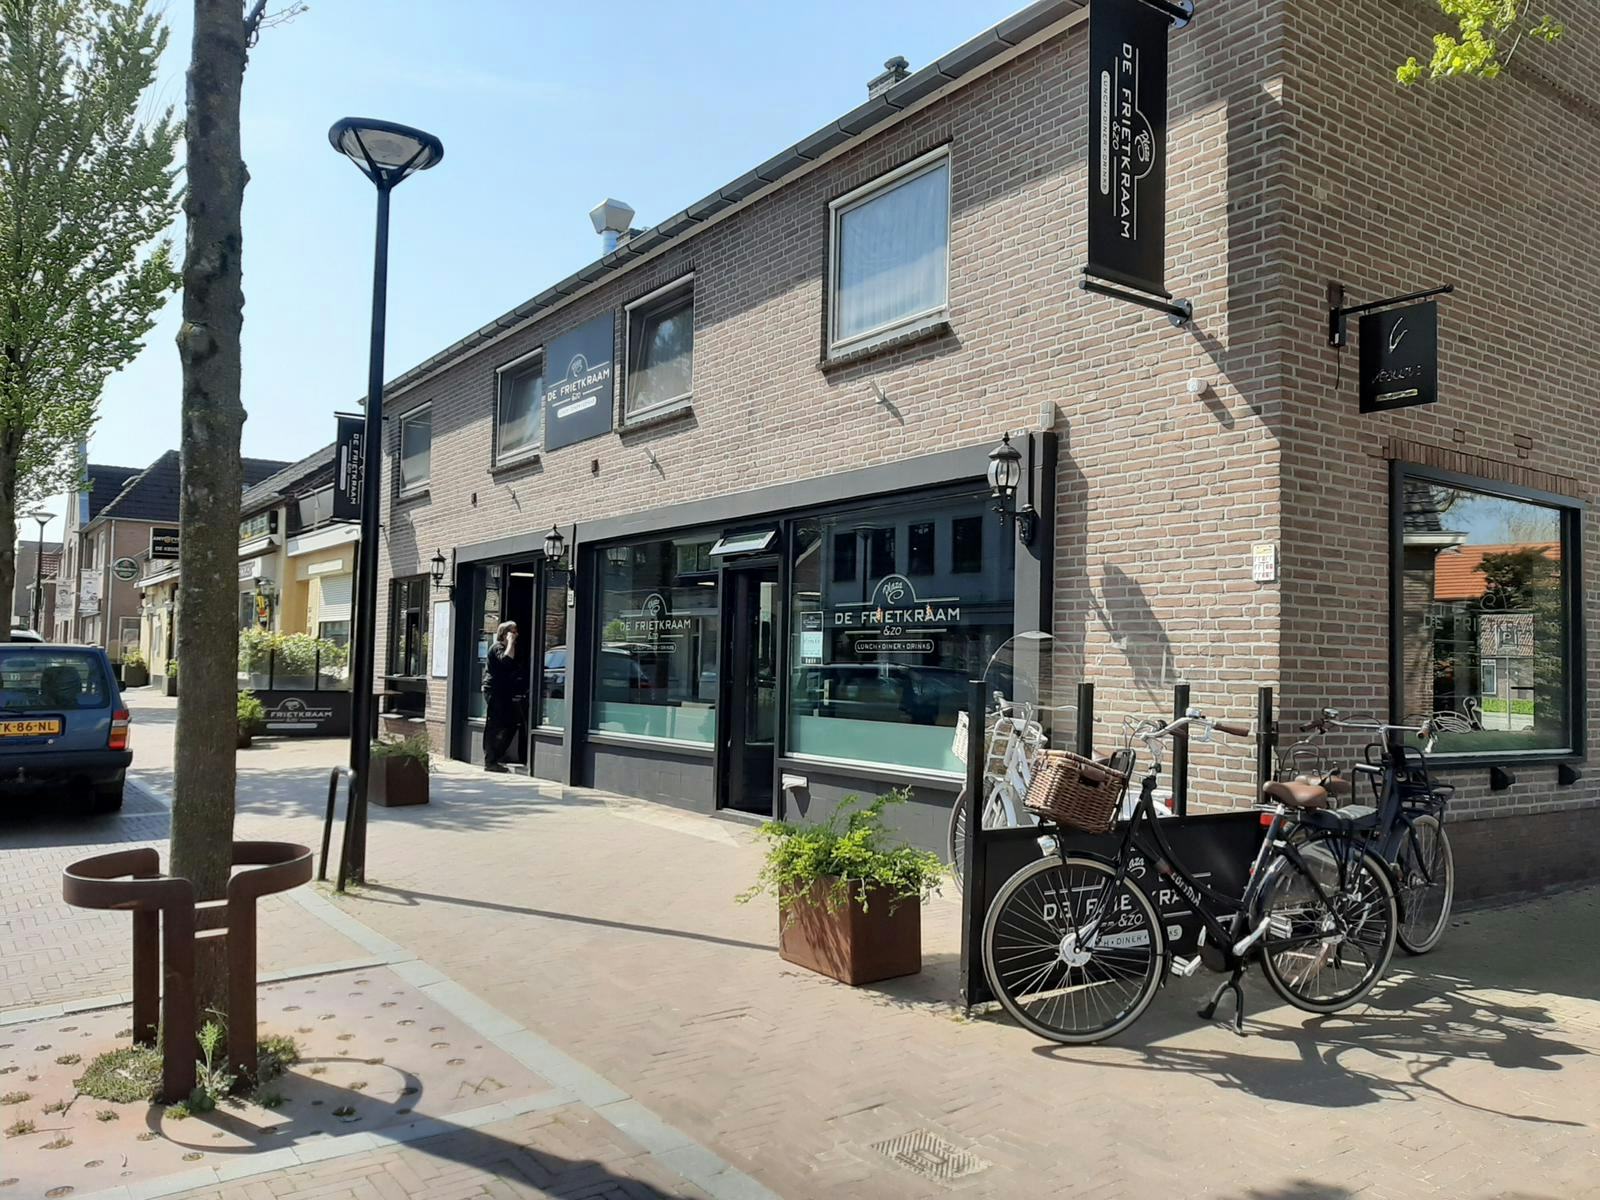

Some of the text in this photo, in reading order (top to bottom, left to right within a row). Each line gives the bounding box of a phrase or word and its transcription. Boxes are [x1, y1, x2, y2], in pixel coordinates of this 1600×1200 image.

[1120, 42, 1132, 239] DE FRIETKRAAM
[547, 390, 557, 401] DE
[560, 368, 610, 396] FRIETKRAAM
[350, 433, 360, 505] DE FRIETKRAAM
[834, 612, 853, 624] DE
[861, 607, 960, 623] FRIETKRAAM
[620, 619, 691, 631] DE FRIETKRAAM
[0, 722, 54, 733] K-86-NL
[1116, 935, 1142, 946] DINER
